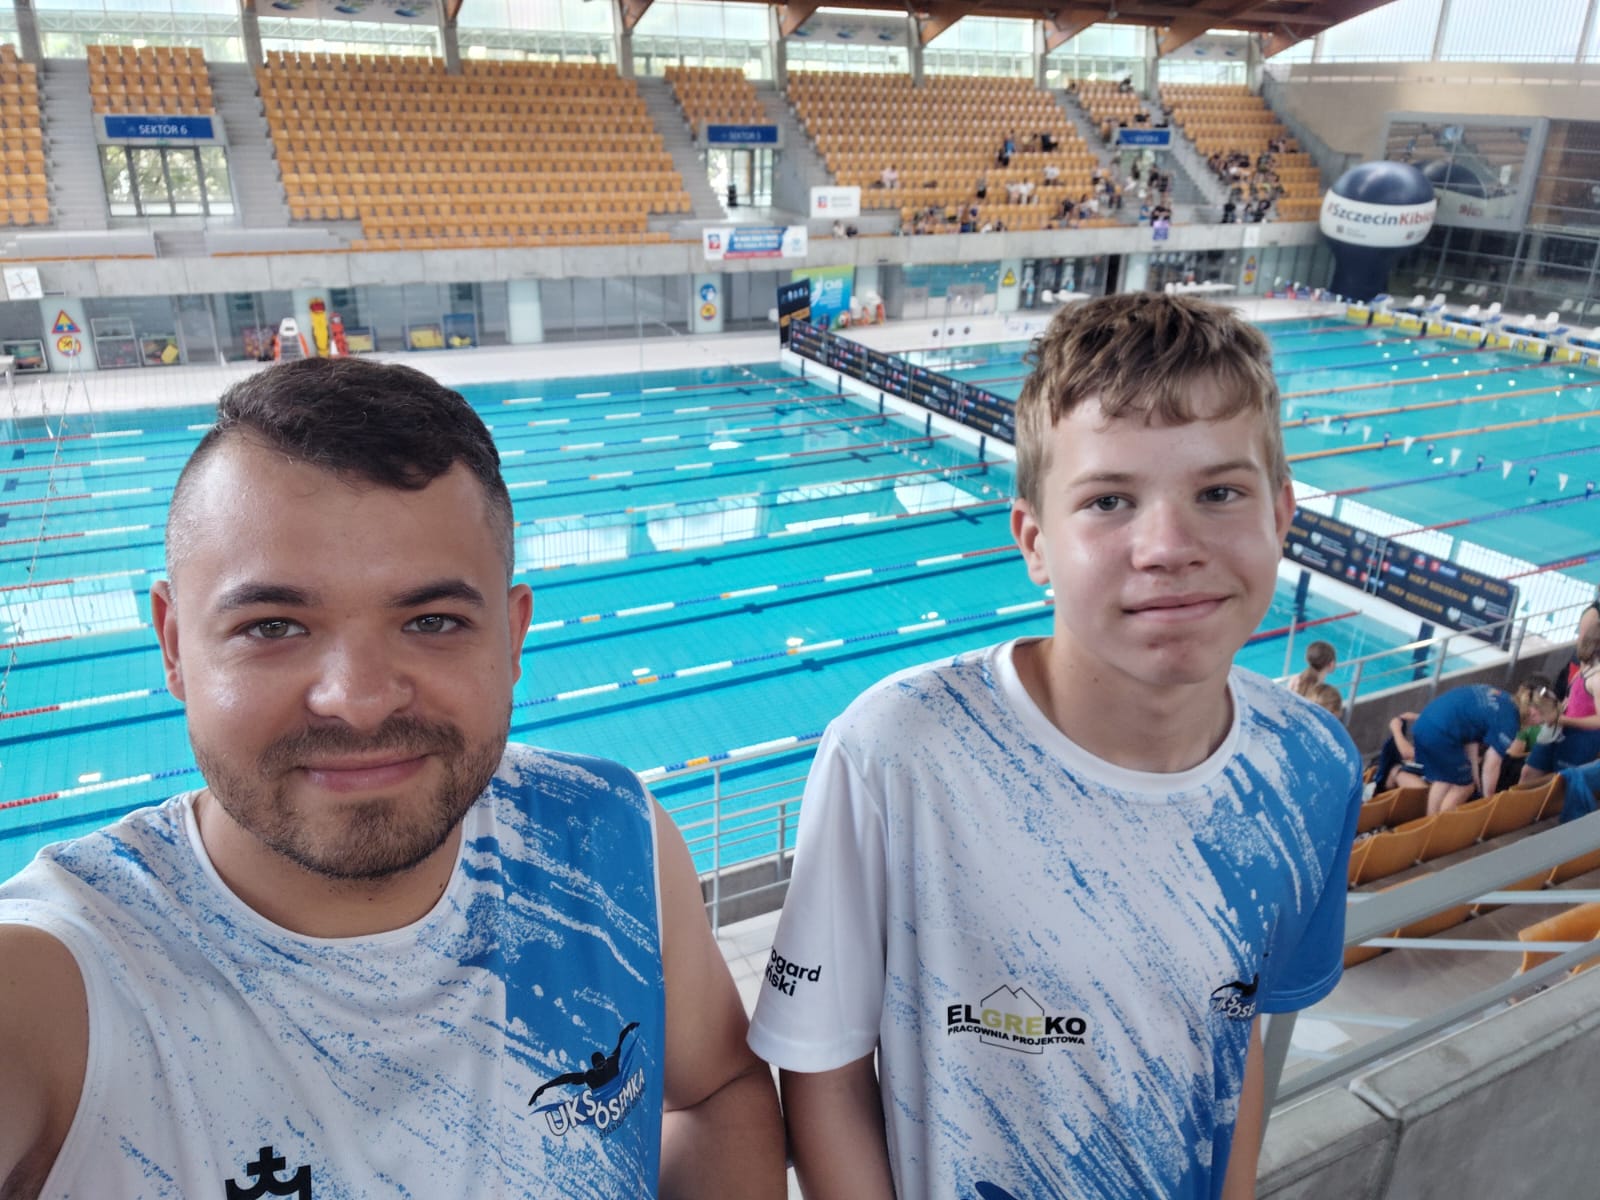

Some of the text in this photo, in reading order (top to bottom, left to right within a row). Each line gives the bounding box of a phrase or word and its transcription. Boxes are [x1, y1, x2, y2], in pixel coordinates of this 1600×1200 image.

[138, 124, 188, 135] SEKTOR 6
[771, 947, 822, 983] ogard
[947, 1003, 1087, 1036] ELGREKO
[947, 1023, 1086, 1046] PRACOWNIA PROJEKTOWA
[545, 1090, 597, 1137] UKS
